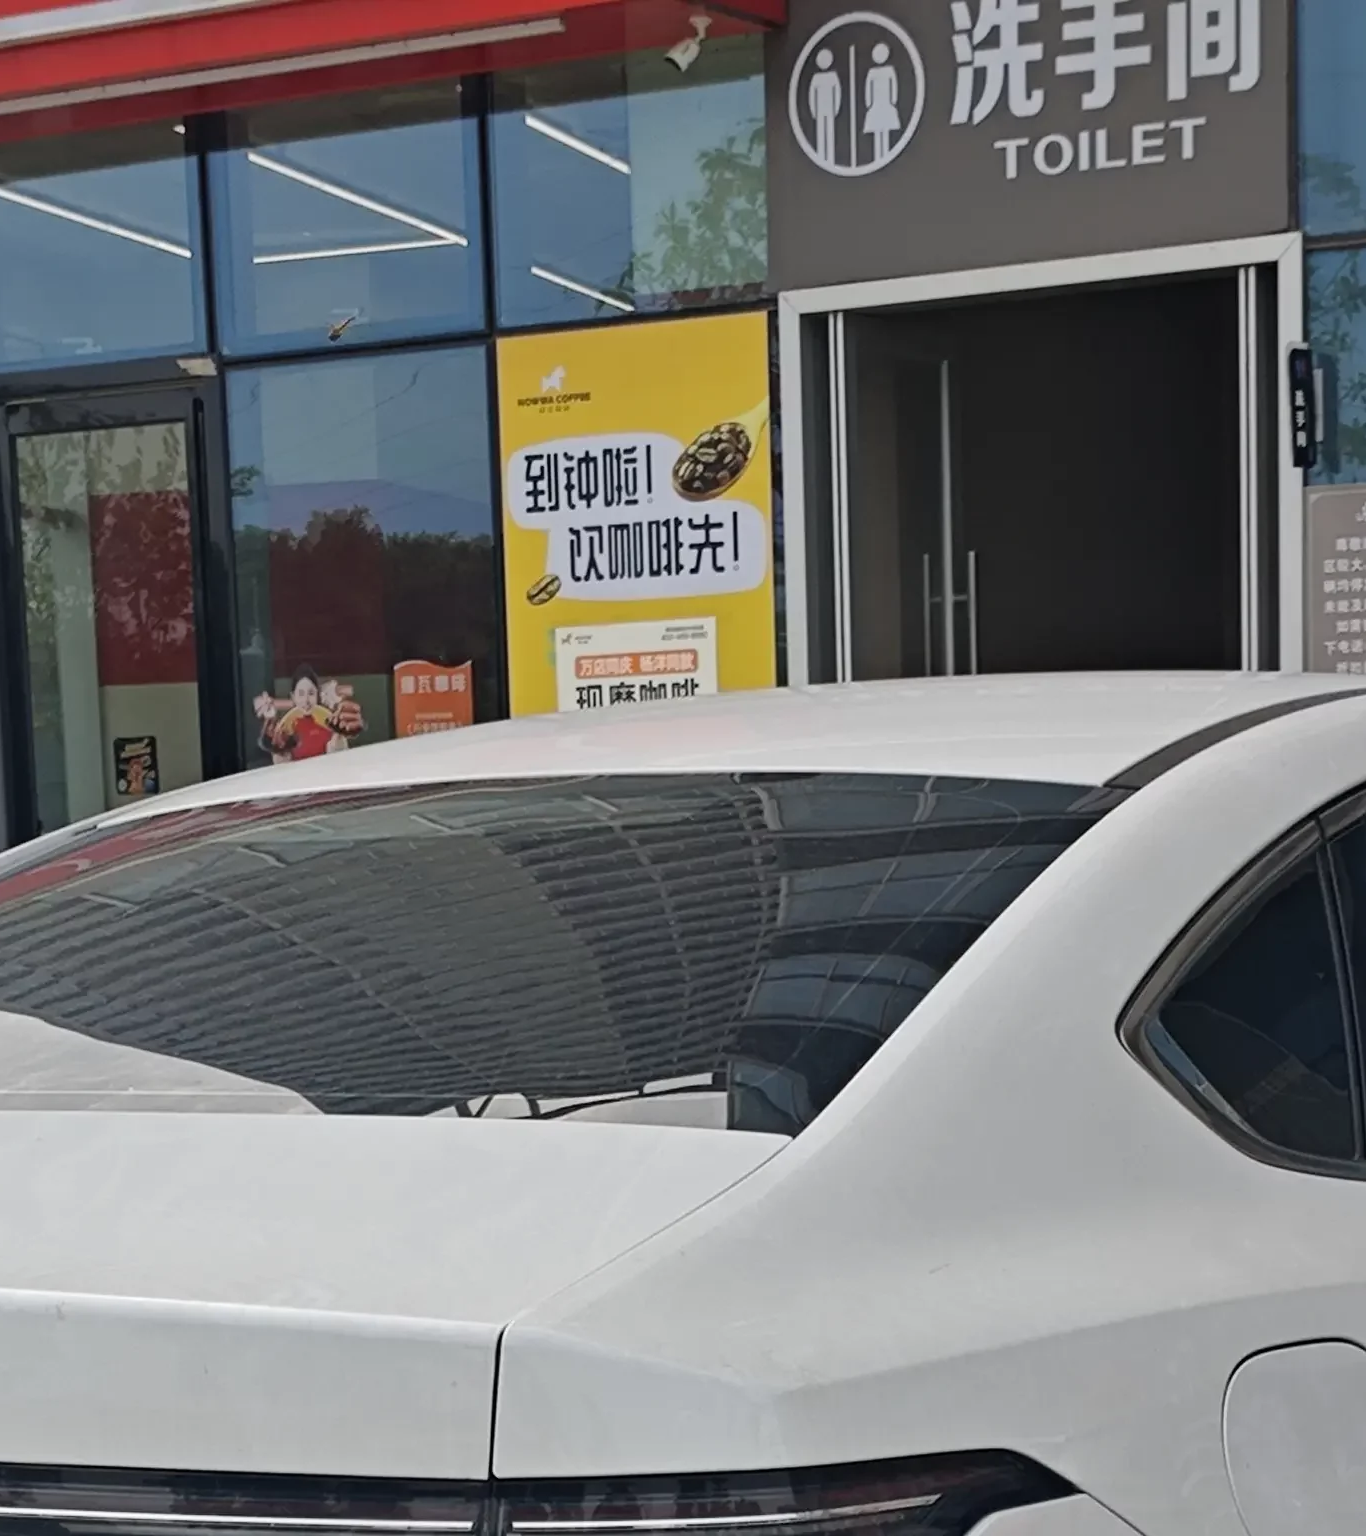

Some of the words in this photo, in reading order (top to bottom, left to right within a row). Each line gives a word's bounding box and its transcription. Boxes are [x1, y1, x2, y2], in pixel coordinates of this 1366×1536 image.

[950, 0, 1261, 125] 洗手间
[993, 116, 1207, 180] TOILET
